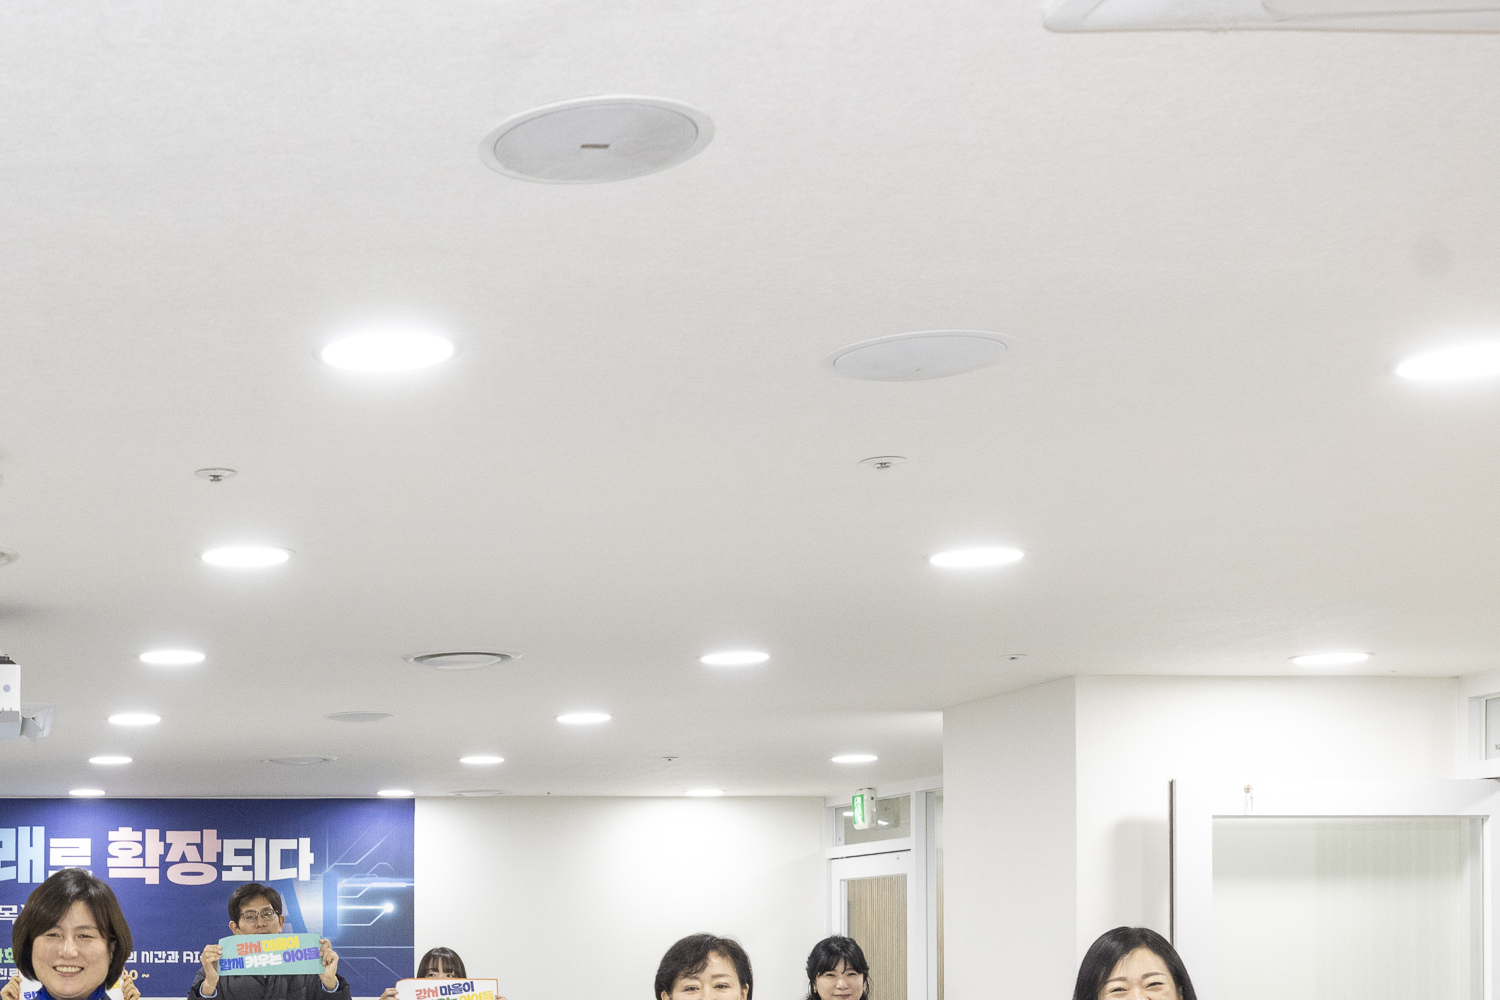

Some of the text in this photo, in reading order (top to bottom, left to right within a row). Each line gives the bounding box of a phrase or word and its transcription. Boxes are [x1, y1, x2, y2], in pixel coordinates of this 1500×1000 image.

[107, 826, 314, 885] 확장되다
[236, 936, 299, 956] 강서 마을이
[141, 951, 179, 963] 시간과
[183, 951, 201, 963] AI
[219, 947, 320, 972] 함께 키우는 아이들
[415, 981, 475, 1000] 강서 마을이
